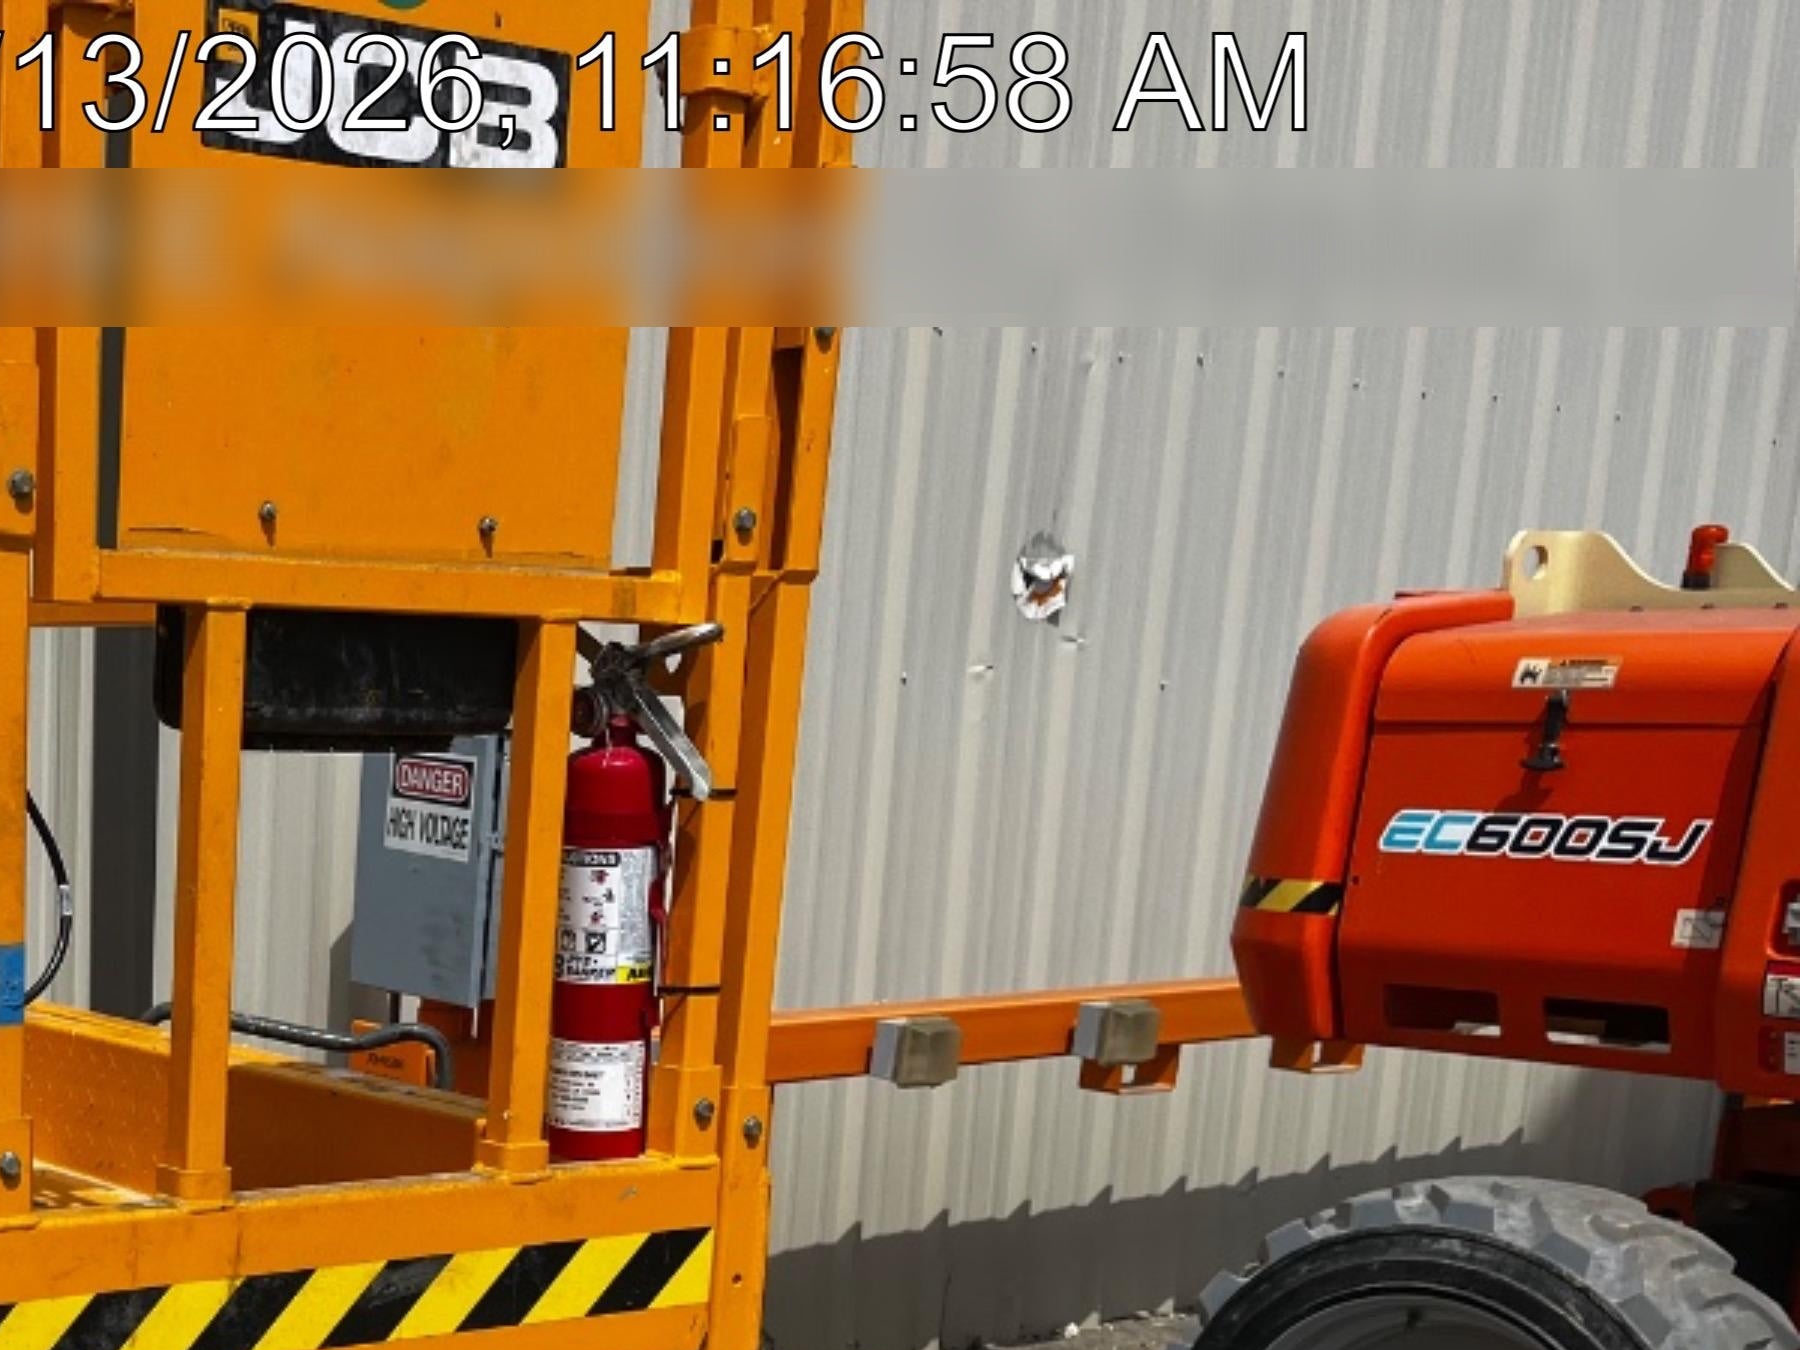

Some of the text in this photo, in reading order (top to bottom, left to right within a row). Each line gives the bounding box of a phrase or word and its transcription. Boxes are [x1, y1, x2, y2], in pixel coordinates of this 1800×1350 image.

[214, 20, 558, 169] JCB
[400, 764, 463, 796] DANGER
[387, 806, 469, 850] HIGH VOLTAGE
[1380, 810, 1713, 866] EC600SJ
